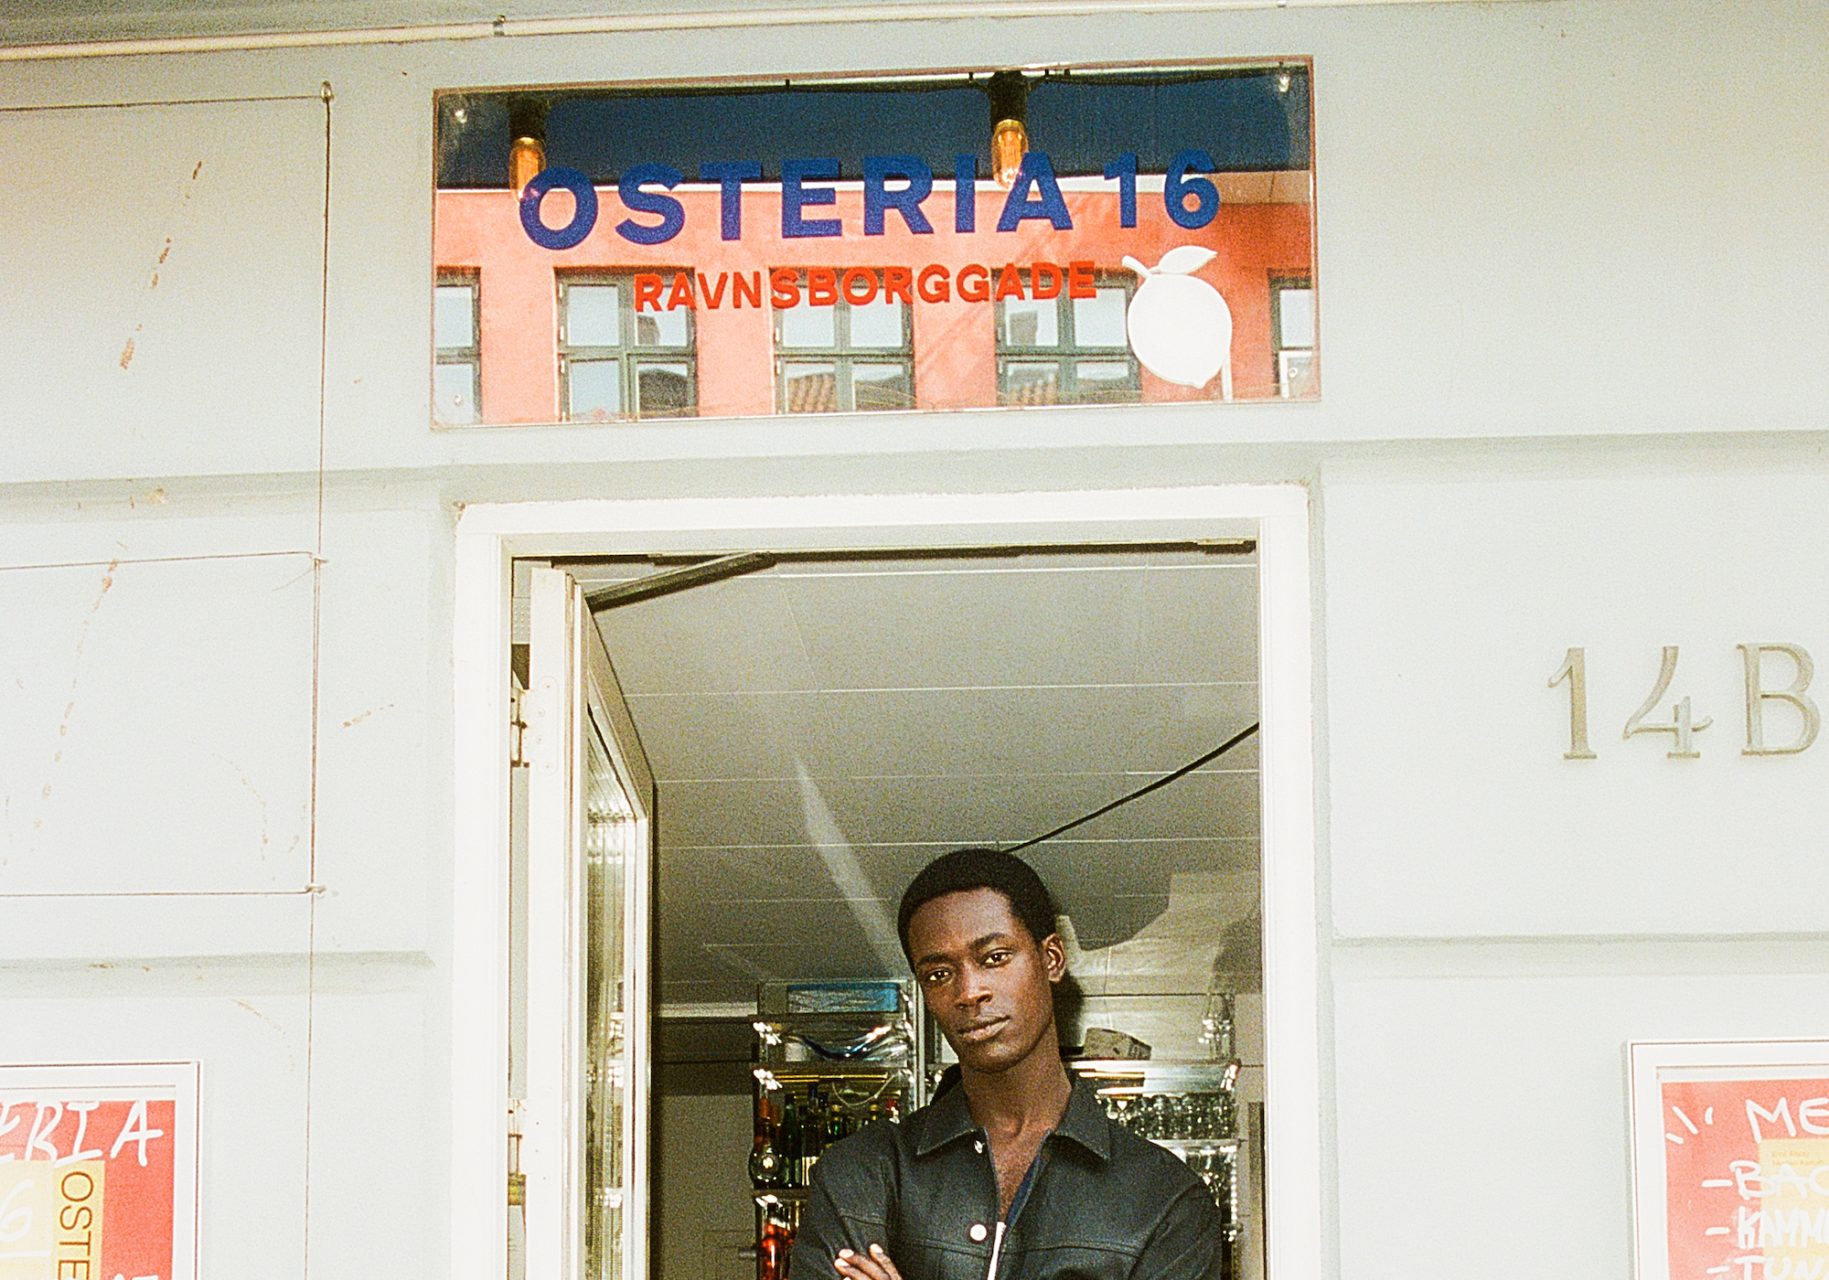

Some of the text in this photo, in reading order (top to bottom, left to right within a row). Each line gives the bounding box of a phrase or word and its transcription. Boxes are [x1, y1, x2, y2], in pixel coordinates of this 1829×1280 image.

[519, 149, 1220, 250] OSTERIA 16
[633, 260, 1098, 313] RAVNSBORGGADE
